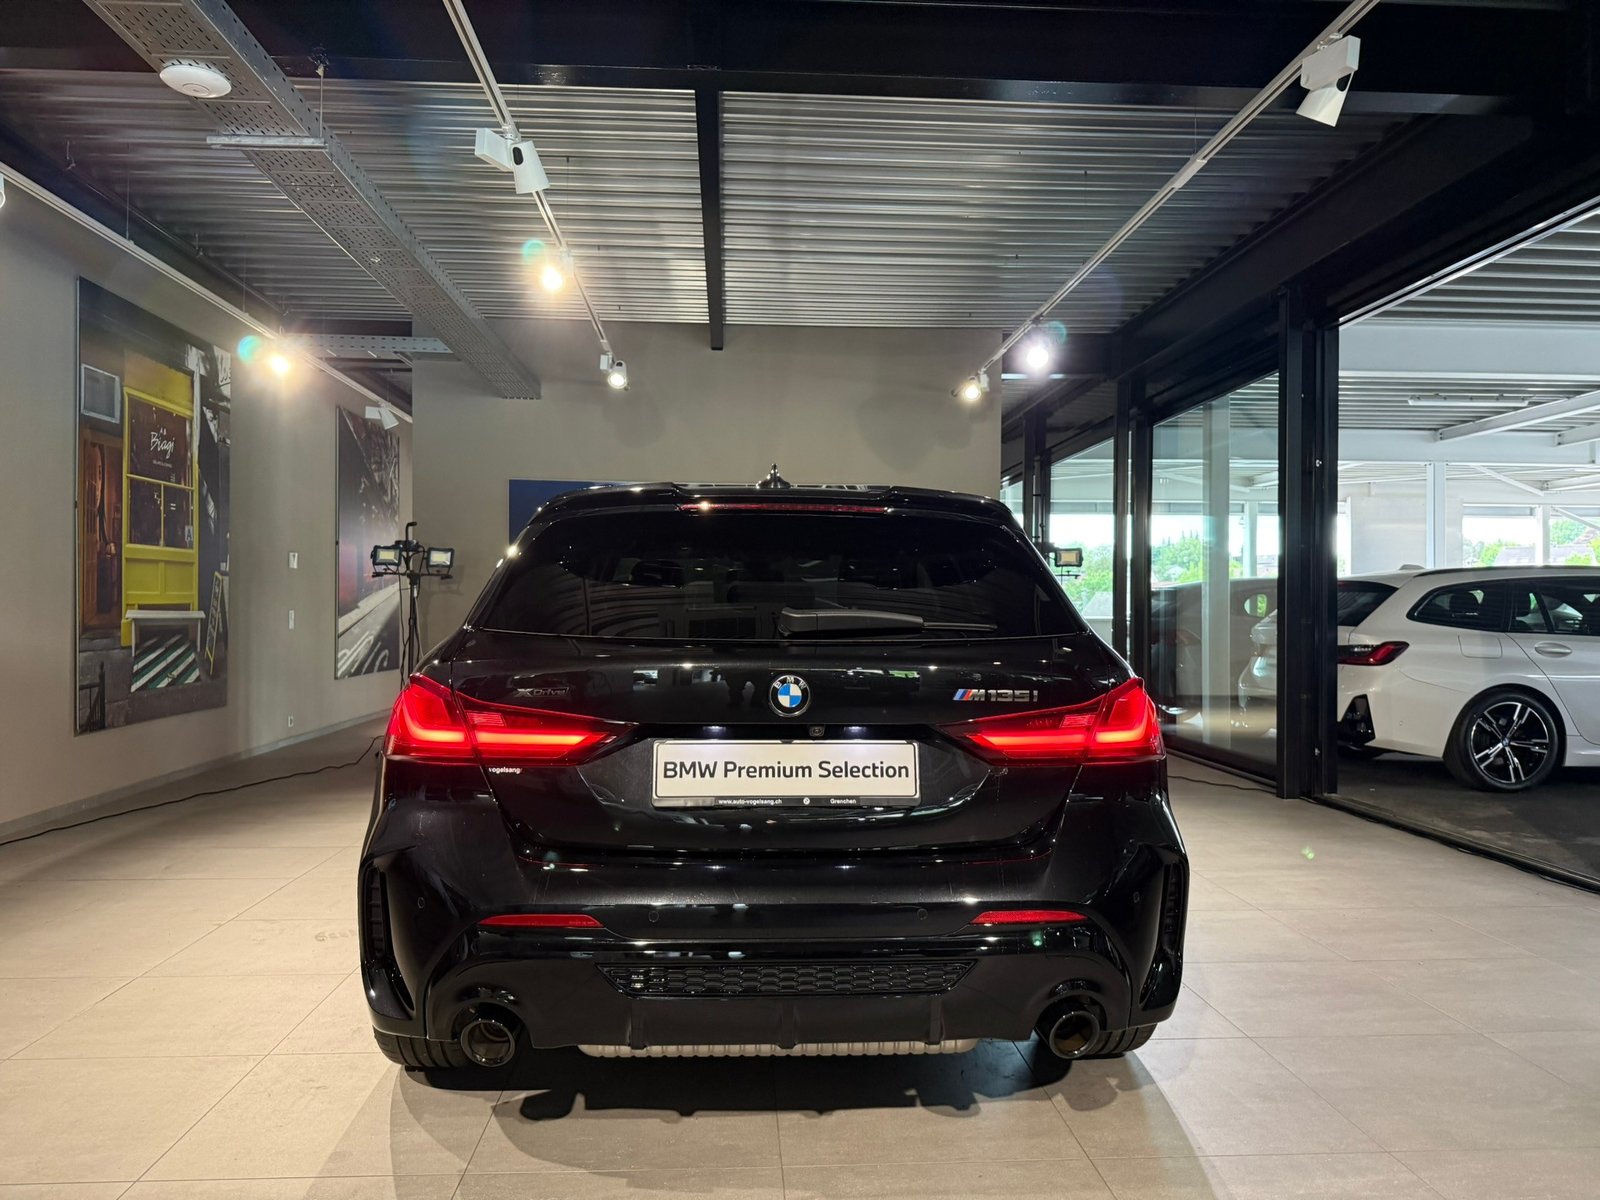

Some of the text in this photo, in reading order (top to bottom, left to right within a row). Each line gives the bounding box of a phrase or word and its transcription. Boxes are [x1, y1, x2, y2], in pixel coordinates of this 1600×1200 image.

[150, 431, 175, 459] Biagi
[488, 766, 522, 775] vogelsang
[663, 760, 910, 779] BMW Premium Selection
[718, 798, 783, 806] www.auto-vogelsang.ch
